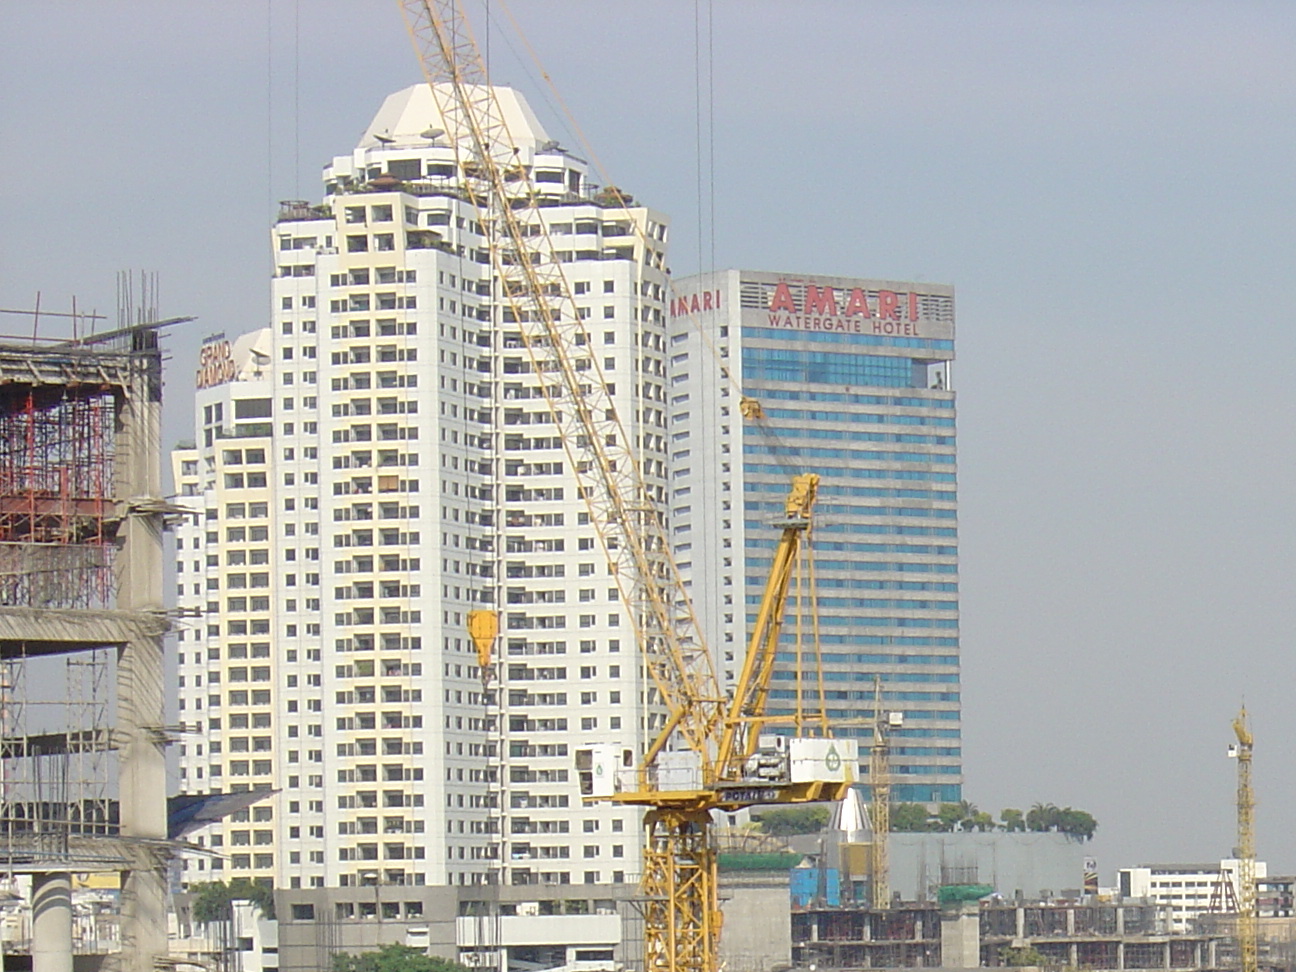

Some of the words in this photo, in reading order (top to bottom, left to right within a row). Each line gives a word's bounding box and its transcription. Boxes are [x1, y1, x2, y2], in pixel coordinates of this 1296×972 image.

[670, 290, 720, 318] AMARI
[769, 282, 920, 322] AMARI
[768, 314, 861, 332] WATERGATE
[872, 321, 919, 337] HOTEL
[200, 340, 231, 367] GRAND
[196, 359, 236, 389] DIAMOND
